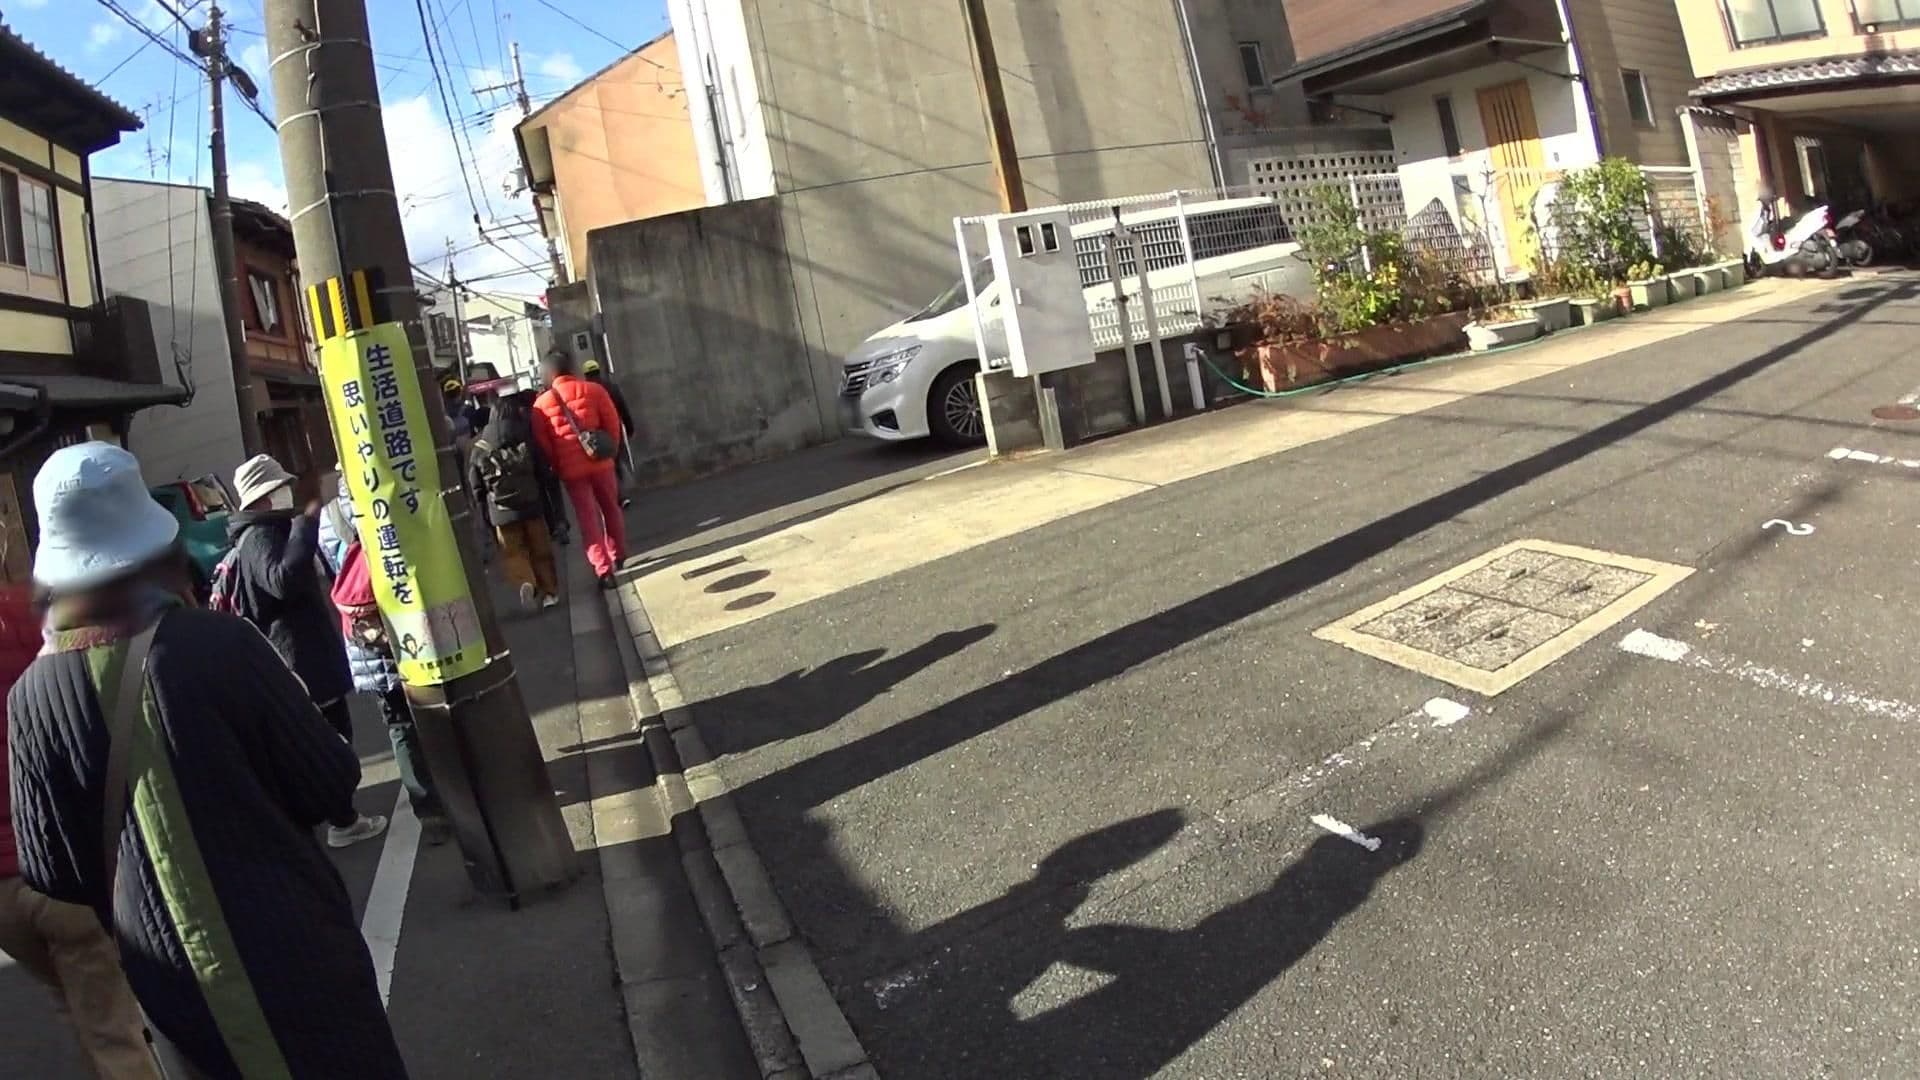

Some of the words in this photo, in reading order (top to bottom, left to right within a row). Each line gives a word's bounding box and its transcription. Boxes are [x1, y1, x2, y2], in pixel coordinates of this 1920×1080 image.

[342, 380, 413, 605] 思いやりの運転を
[366, 343, 421, 515] 生活道路です
